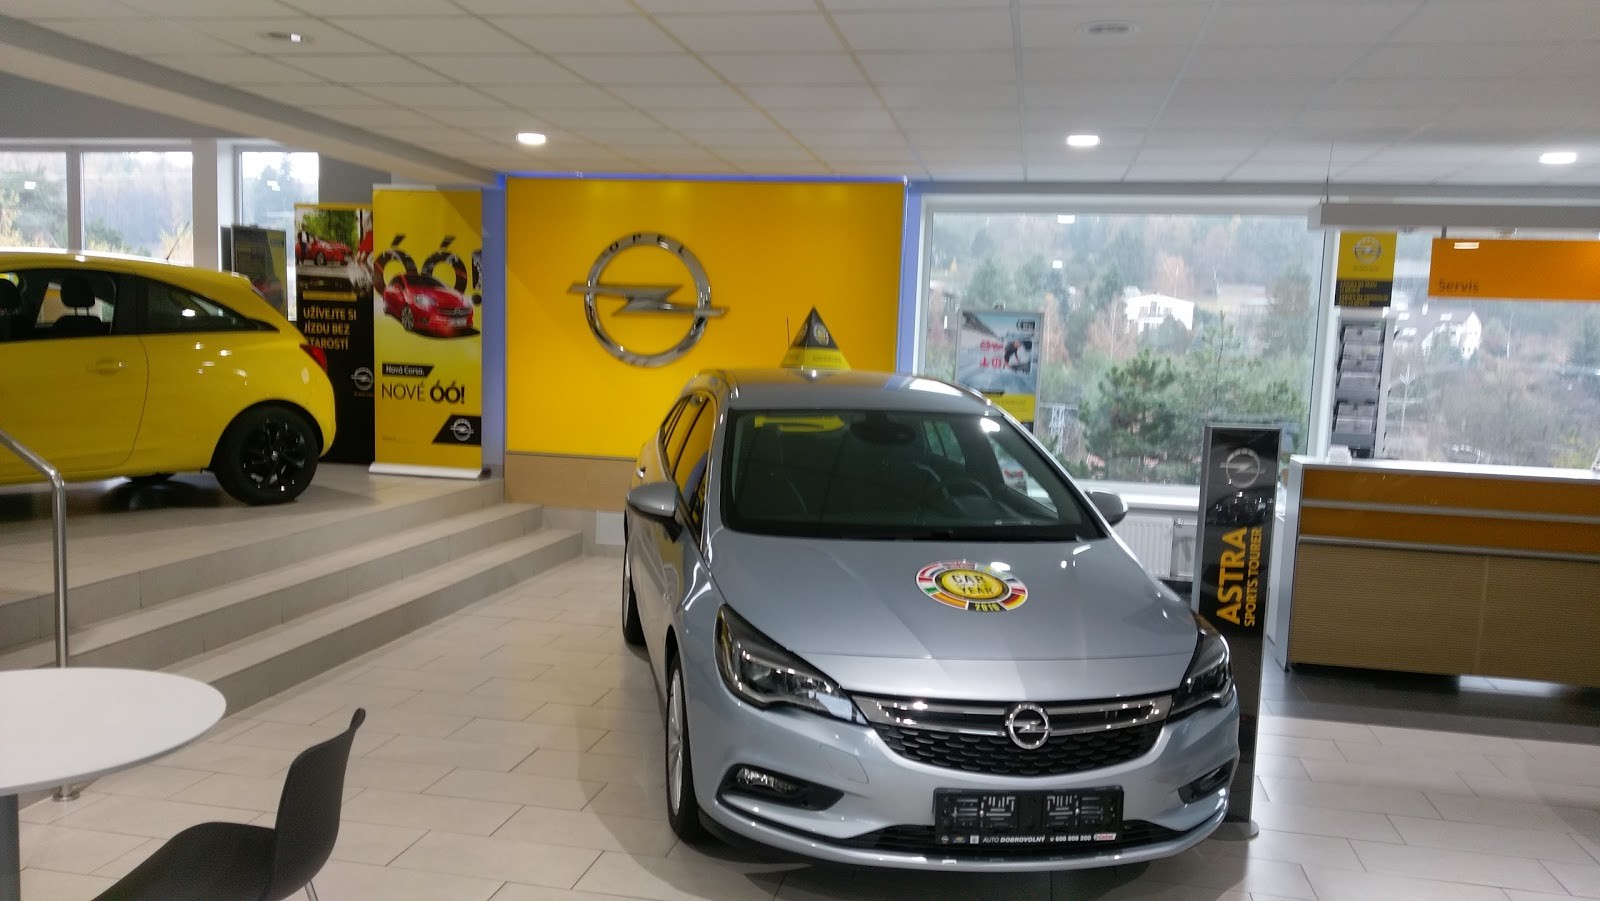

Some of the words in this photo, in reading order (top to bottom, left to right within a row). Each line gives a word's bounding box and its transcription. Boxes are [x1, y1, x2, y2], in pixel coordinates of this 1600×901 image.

[609, 233, 685, 254] OPEL
[1439, 278, 1479, 293] Servis
[303, 305, 346, 320] UŽÍVEJTE
[348, 308, 357, 320] SI
[304, 321, 330, 335] JÍZDU
[332, 323, 351, 335] BEZ
[306, 336, 349, 350] TAROSTÍ
[381, 380, 425, 402] NOVÉ
[430, 379, 465, 406] ÓÓ!
[1248, 526, 1263, 577] TOURER
[951, 575, 985, 585] CAR
[1216, 526, 1247, 625] ASTRA
[959, 586, 994, 596] YEAR
[1244, 579, 1258, 627] SPORTS
[1000, 835, 1046, 843] DOBROVOLNÝ
